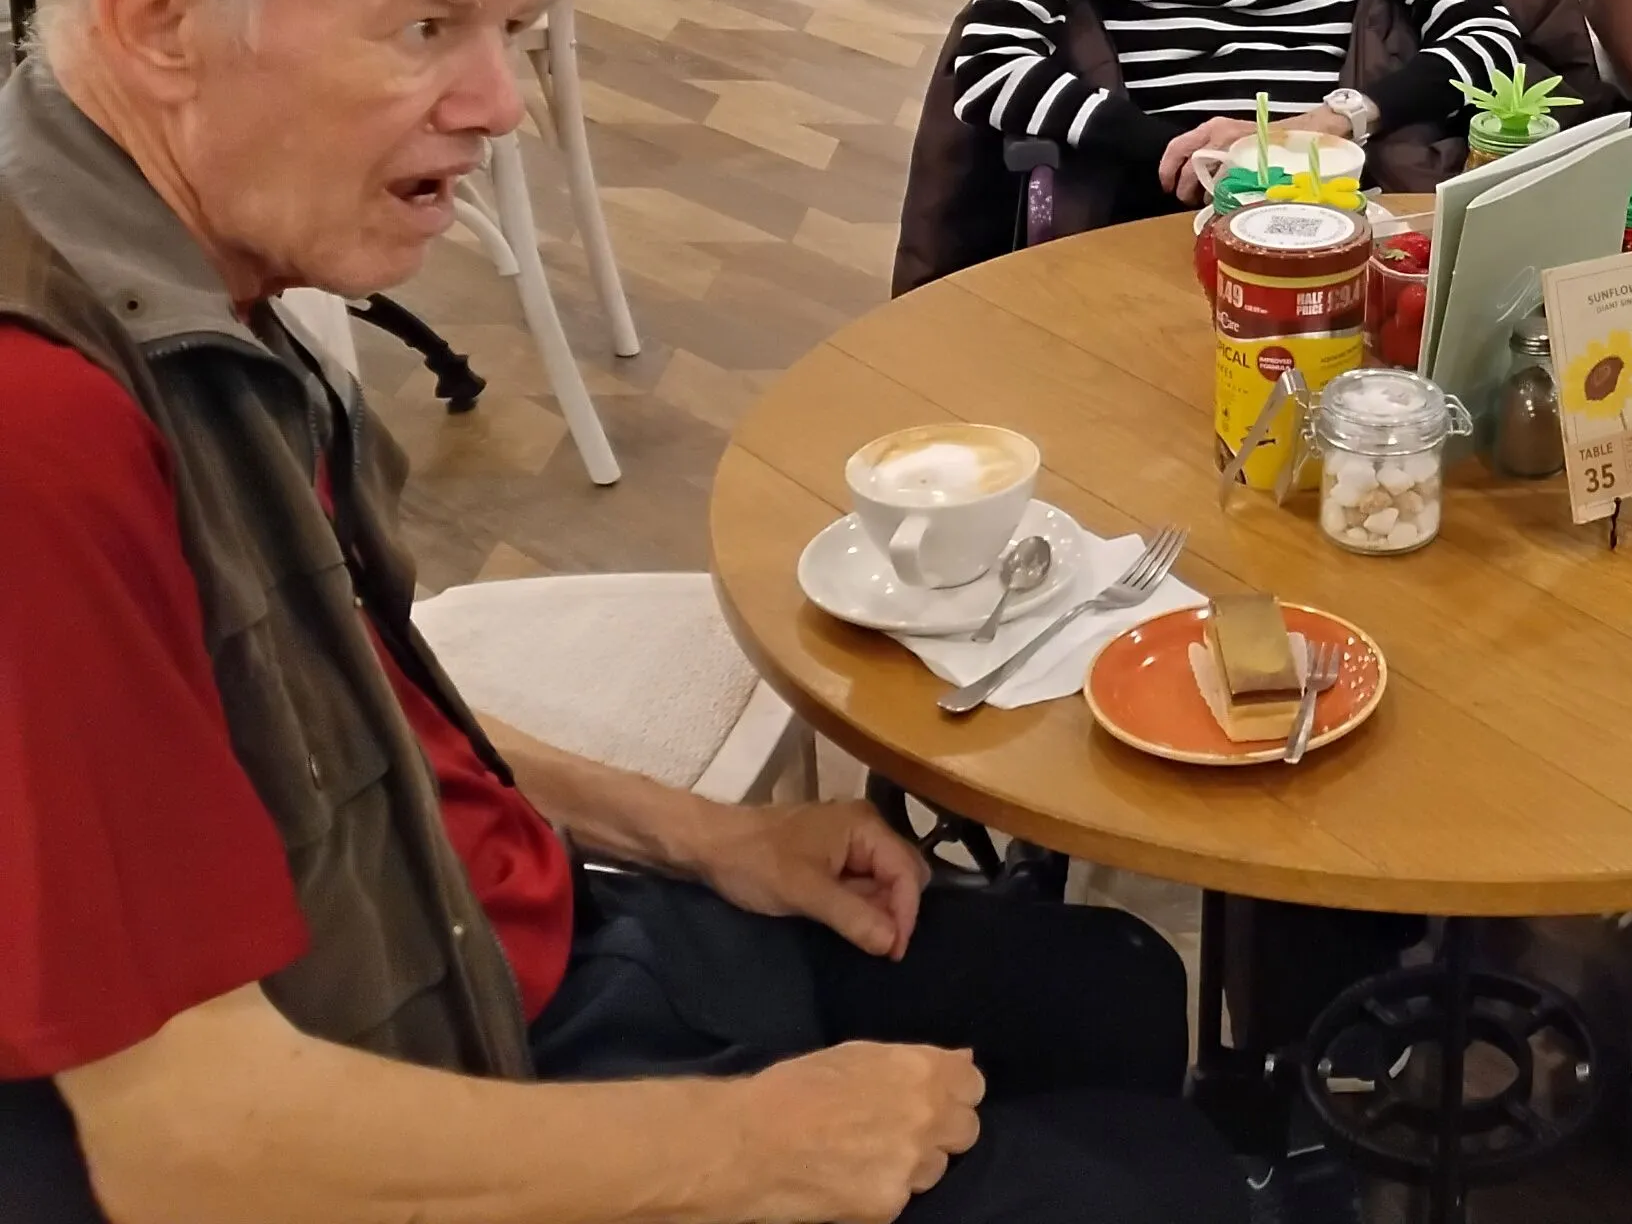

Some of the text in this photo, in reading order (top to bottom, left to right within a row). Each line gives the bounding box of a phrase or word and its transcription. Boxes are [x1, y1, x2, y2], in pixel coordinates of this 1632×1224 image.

[1297, 291, 1323, 304] HALF
[1296, 304, 1323, 316] PRICE
[1579, 442, 1613, 461] TABLE
[1584, 463, 1615, 493] 35
